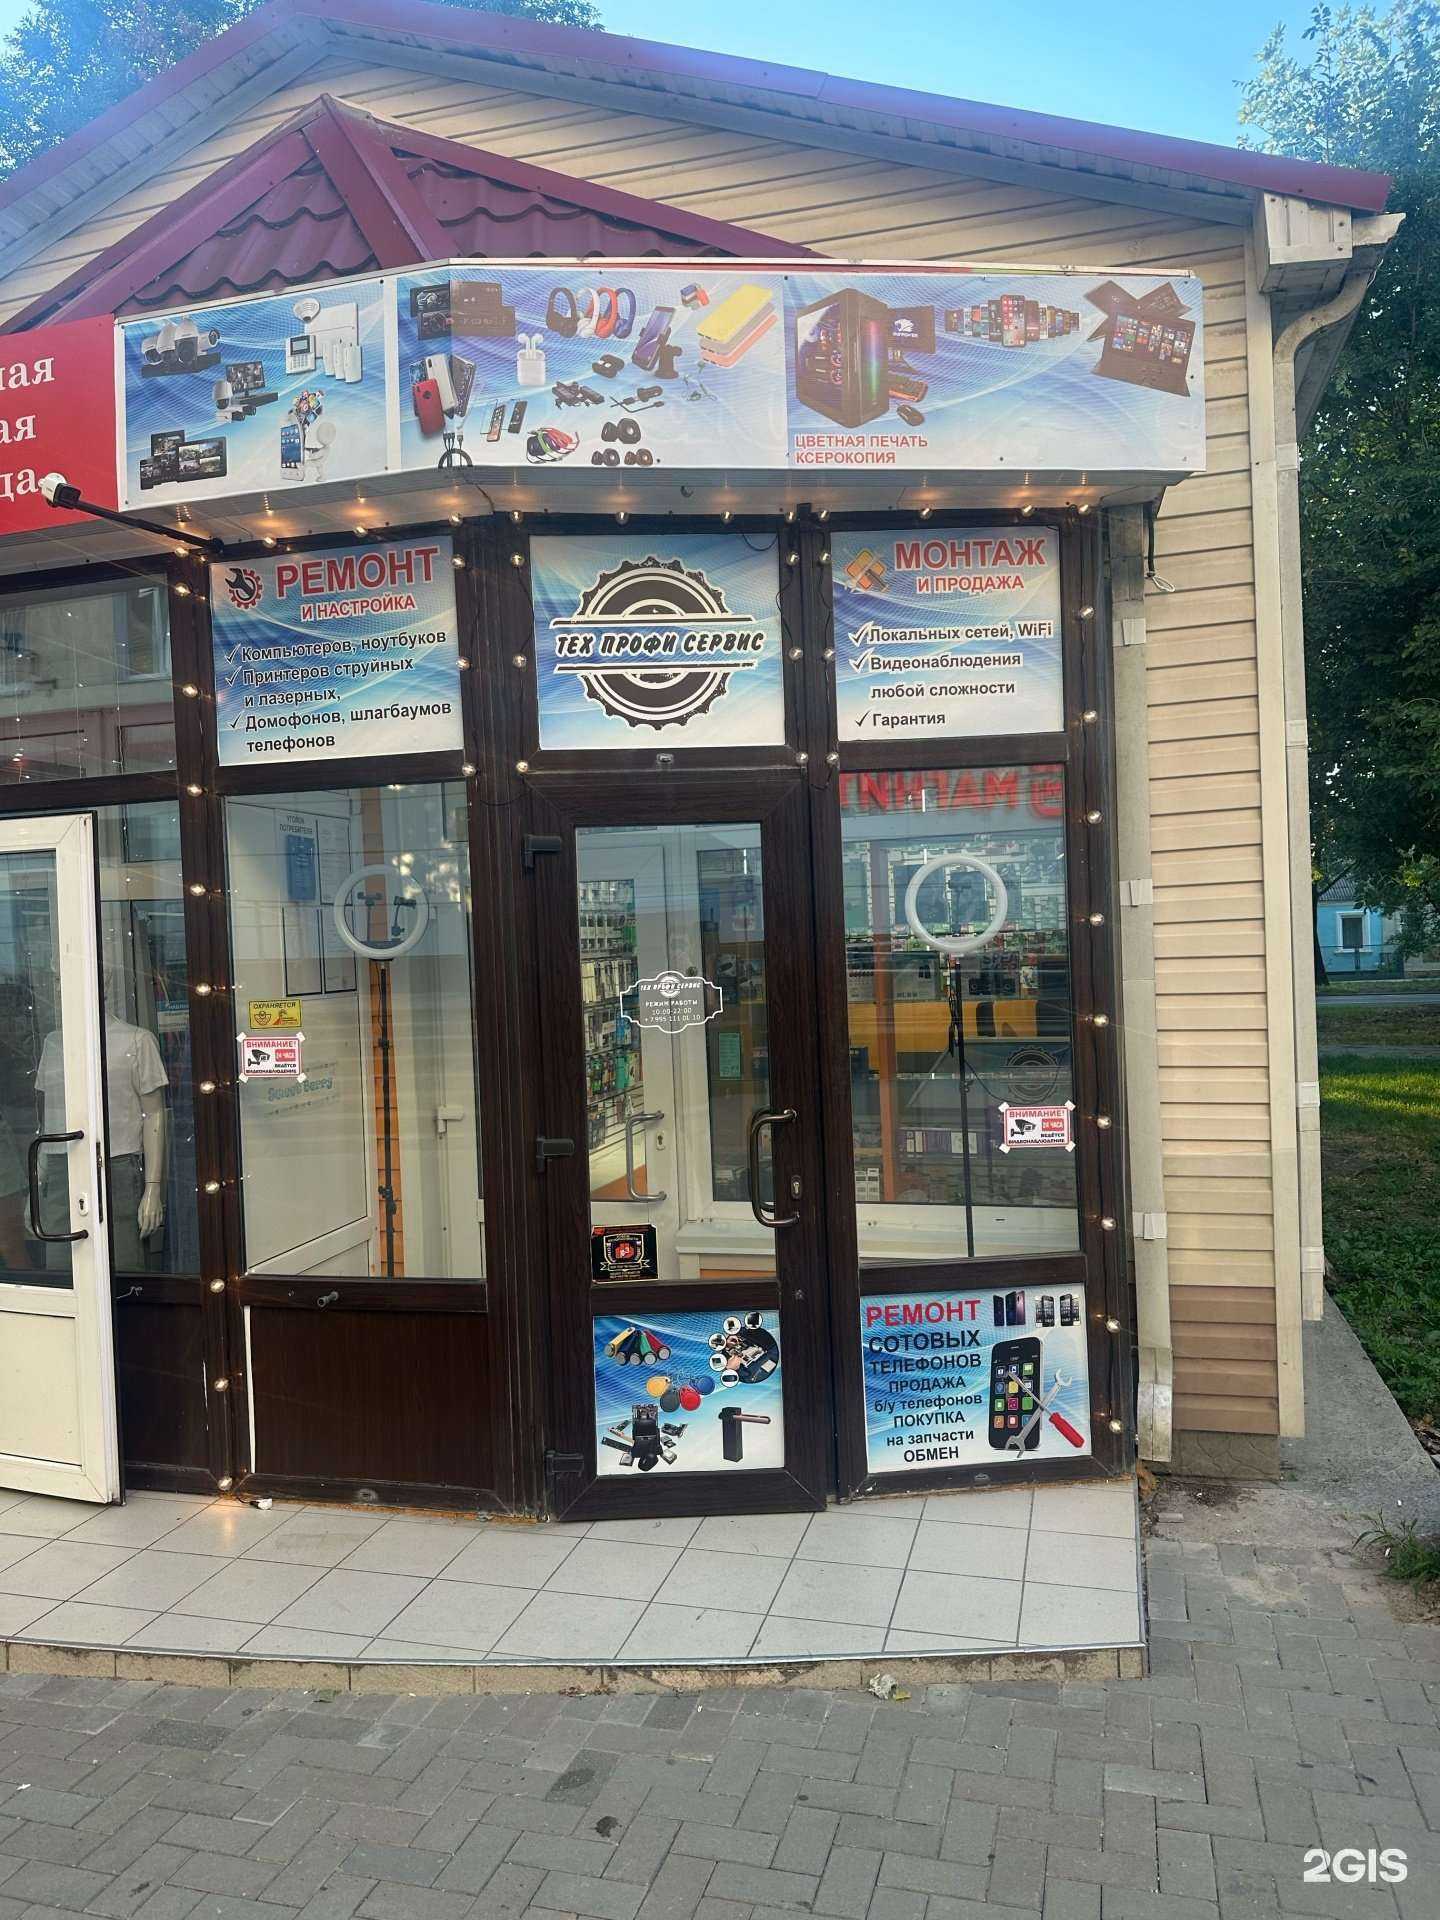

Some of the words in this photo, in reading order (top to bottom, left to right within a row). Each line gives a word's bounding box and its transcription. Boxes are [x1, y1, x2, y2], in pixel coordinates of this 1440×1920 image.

[0, 357, 55, 391] ая
[795, 435, 865, 449] ЦВЕТНАЯ
[869, 435, 928, 448] ПЕЧАТЬ
[795, 451, 896, 465] КСЕРОКОПИЯ
[895, 539, 1046, 570] МОНТАЖ
[276, 547, 439, 598] РЕМОНТ
[918, 578, 929, 593] И
[935, 575, 1025, 593] ПРОДАЖА
[302, 605, 313, 621] И
[318, 594, 416, 618] НАСТРОЙКА
[869, 626, 961, 643] Локальных
[965, 623, 1014, 640] сетей,
[1018, 622, 1053, 637] WiFi
[242, 639, 356, 662] Компьютеров,
[361, 630, 447, 653] ноутбуков
[557, 635, 594, 655] ТЕХ
[601, 634, 677, 655] ПРОФИ
[683, 632, 765, 652] СЕРВИС
[243, 665, 330, 687] Принтеров
[334, 656, 414, 678] струйных
[870, 652, 1022, 672] Видеонаблюдения
[244, 696, 254, 707] и
[258, 687, 341, 707] лазерных,
[870, 683, 925, 699] любой
[929, 682, 1016, 697] сложности
[245, 711, 346, 733] Домофонов,
[350, 702, 452, 723] шлагбаумов
[872, 711, 946, 729] Гарантия
[247, 734, 336, 753] телефонов
[246, 1040, 297, 1049] ВНИМАНИЕ!
[1009, 1110, 1065, 1118] ВНИМАНИЕ!
[866, 1299, 981, 1327] РЕМОНТ
[868, 1329, 981, 1354] СОТОВЫХ
[869, 1353, 981, 1376] ТЕЛЕФОНОВ
[889, 1375, 966, 1394] ПРОДАЖА
[874, 1399, 895, 1414] б/у
[899, 1394, 983, 1410] телефонов
[894, 1410, 966, 1429] ПОКУПКА
[886, 1436, 904, 1447] на
[908, 1429, 974, 1445] запчасти
[903, 1446, 959, 1463] ОБМЕН
